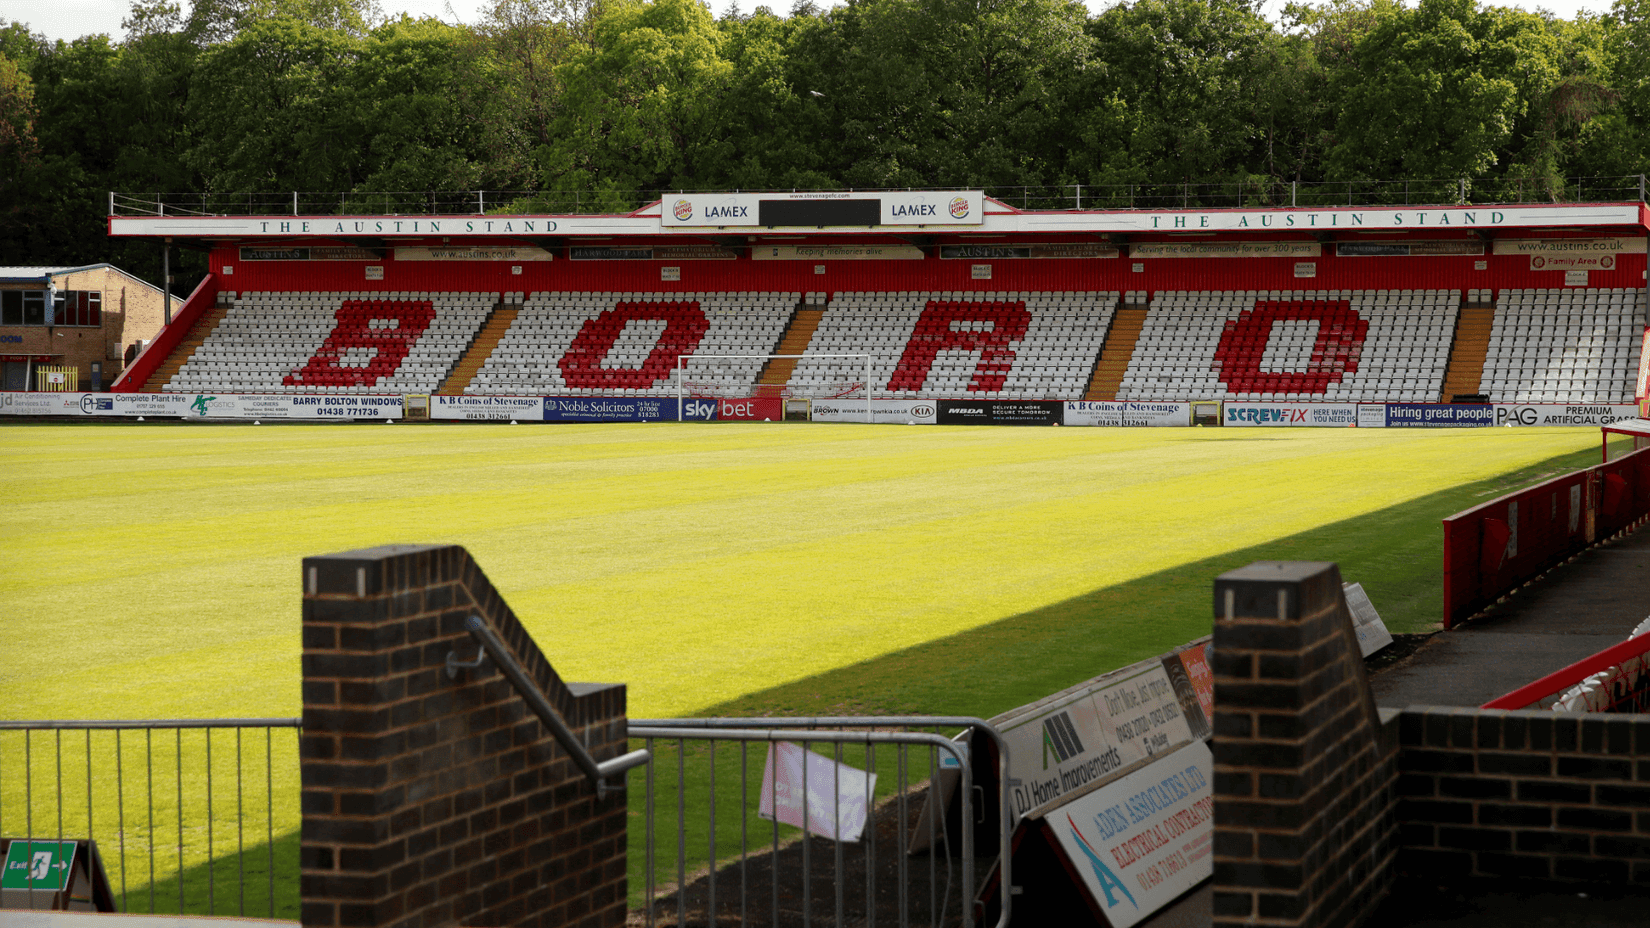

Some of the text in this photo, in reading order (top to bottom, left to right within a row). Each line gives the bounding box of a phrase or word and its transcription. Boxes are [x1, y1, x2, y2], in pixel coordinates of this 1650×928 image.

[675, 206, 693, 217] KING
[705, 206, 748, 217] LAMEX
[892, 204, 936, 216] LAMEX
[951, 204, 969, 215] KING
[1151, 211, 1505, 228] THE AUSTIN STAND
[260, 220, 558, 233] THE AUSTIN STAND
[1137, 245, 1163, 254] Serving
[1200, 245, 1239, 254] community
[1241, 244, 1254, 253] for
[1518, 240, 1624, 252] www.austins.co.uk
[432, 249, 516, 259] www.austins.co.uk
[625, 249, 648, 257] PARK
[796, 248, 824, 257] Keeping
[1548, 257, 1597, 266] Family Area
[115, 395, 149, 403] Complete
[293, 397, 403, 406] BARRY BOLTON WINDOWS
[440, 396, 539, 407] K B Coins of Stevenage
[559, 400, 635, 412] Noble Solicitors
[685, 401, 754, 420] sky bet
[914, 407, 931, 416] KIA
[1068, 401, 1076, 410] K
[1079, 401, 1086, 410] B
[1089, 401, 1115, 411] Coins
[1117, 401, 1127, 411] of
[1130, 402, 1180, 414] Stevenage
[1566, 406, 1613, 415] PREMIUM
[317, 408, 379, 416] 01438 771736
[1228, 408, 1308, 424] SCREWFIX
[1390, 406, 1493, 421] Hiring great people
[1497, 407, 1538, 425] PAG
[1544, 415, 1597, 424] ARTIFICIAL
[1031, 777, 1061, 806] Home
[1059, 744, 1121, 793] Improvements
[1092, 765, 1207, 841] ADEN ASSOCIATES LTD
[1110, 824, 1170, 870] ELECTRICAL
[9, 860, 28, 870] Exit
[1136, 864, 1164, 891] 01438
